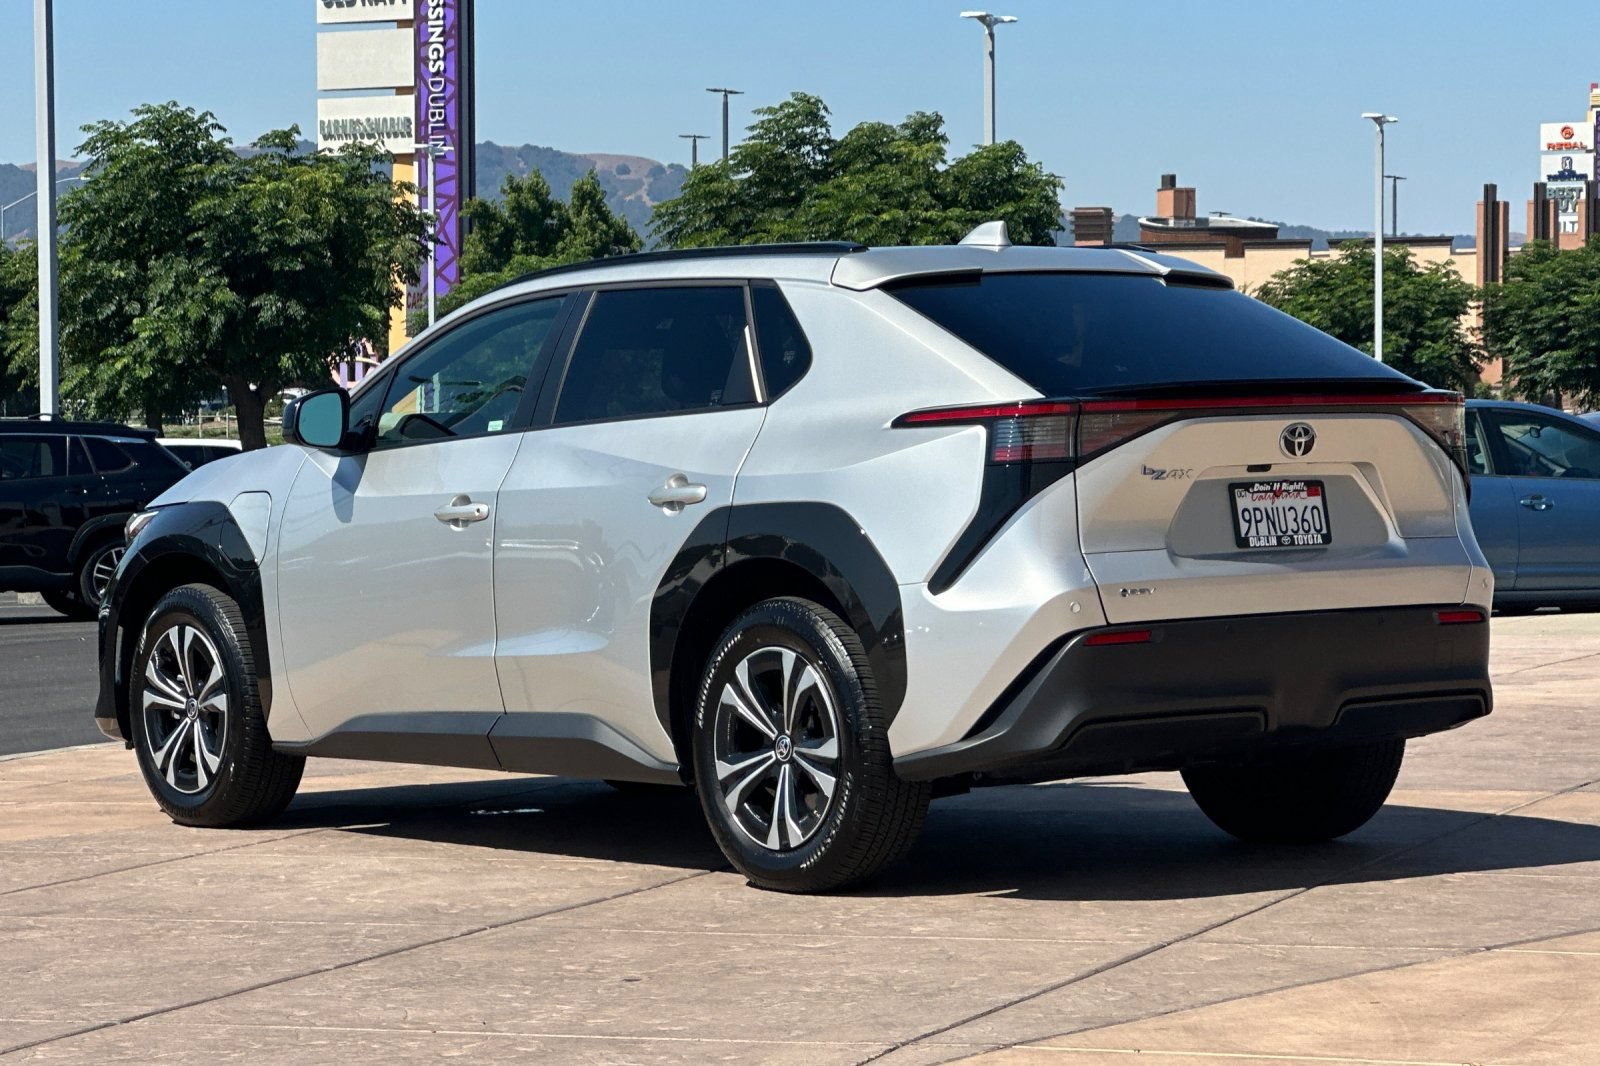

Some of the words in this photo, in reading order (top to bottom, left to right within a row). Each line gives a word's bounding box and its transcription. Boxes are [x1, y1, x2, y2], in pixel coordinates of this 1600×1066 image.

[1546, 187, 1583, 199] BEST
[1558, 198, 1578, 212] UY
[1241, 505, 1324, 537] 9PNU360
[1249, 535, 1278, 547] DUBLIN
[1293, 534, 1323, 545] TOYOTA
